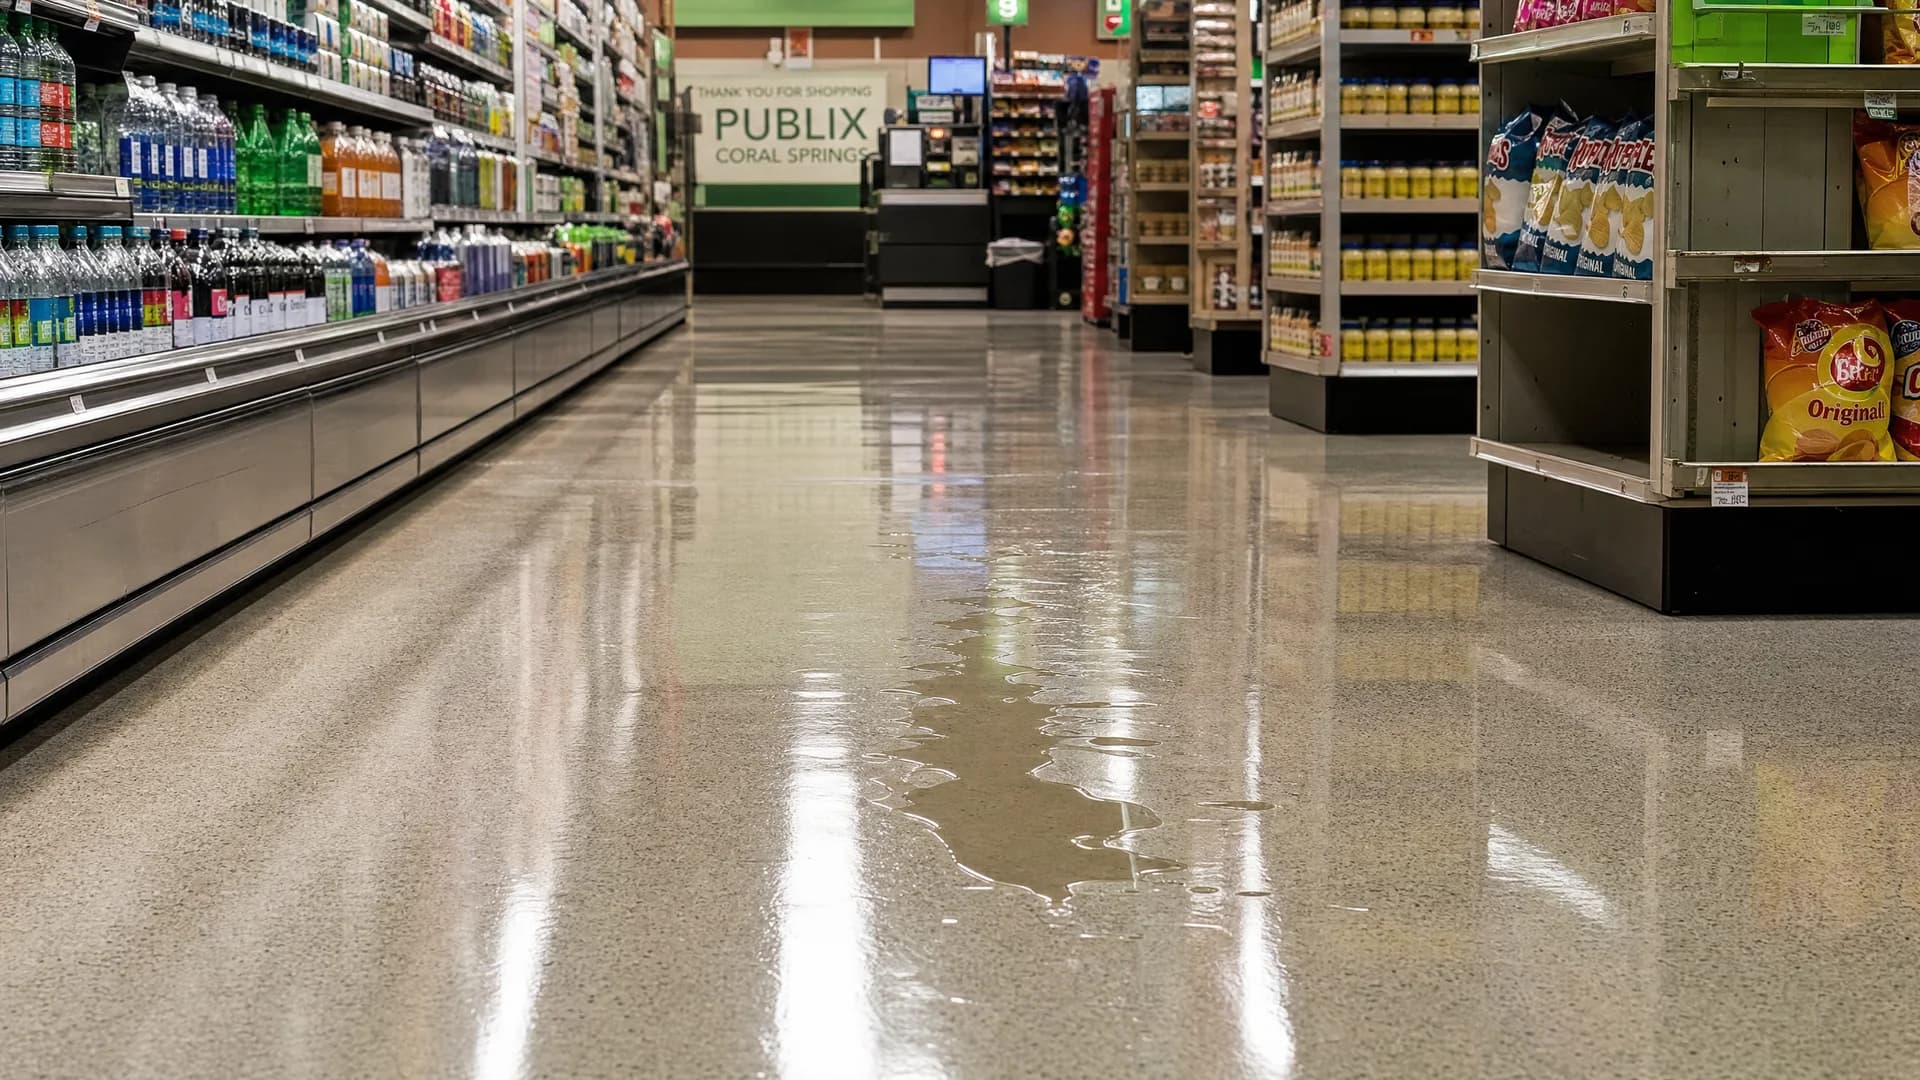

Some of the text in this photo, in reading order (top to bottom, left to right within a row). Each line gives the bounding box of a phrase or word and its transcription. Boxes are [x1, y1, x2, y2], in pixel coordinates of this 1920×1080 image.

[698, 86, 872, 98] THANK YOU FOR SHOPPING
[715, 107, 867, 141] PUBLIX
[715, 147, 868, 164] CORAL SPRINGS
